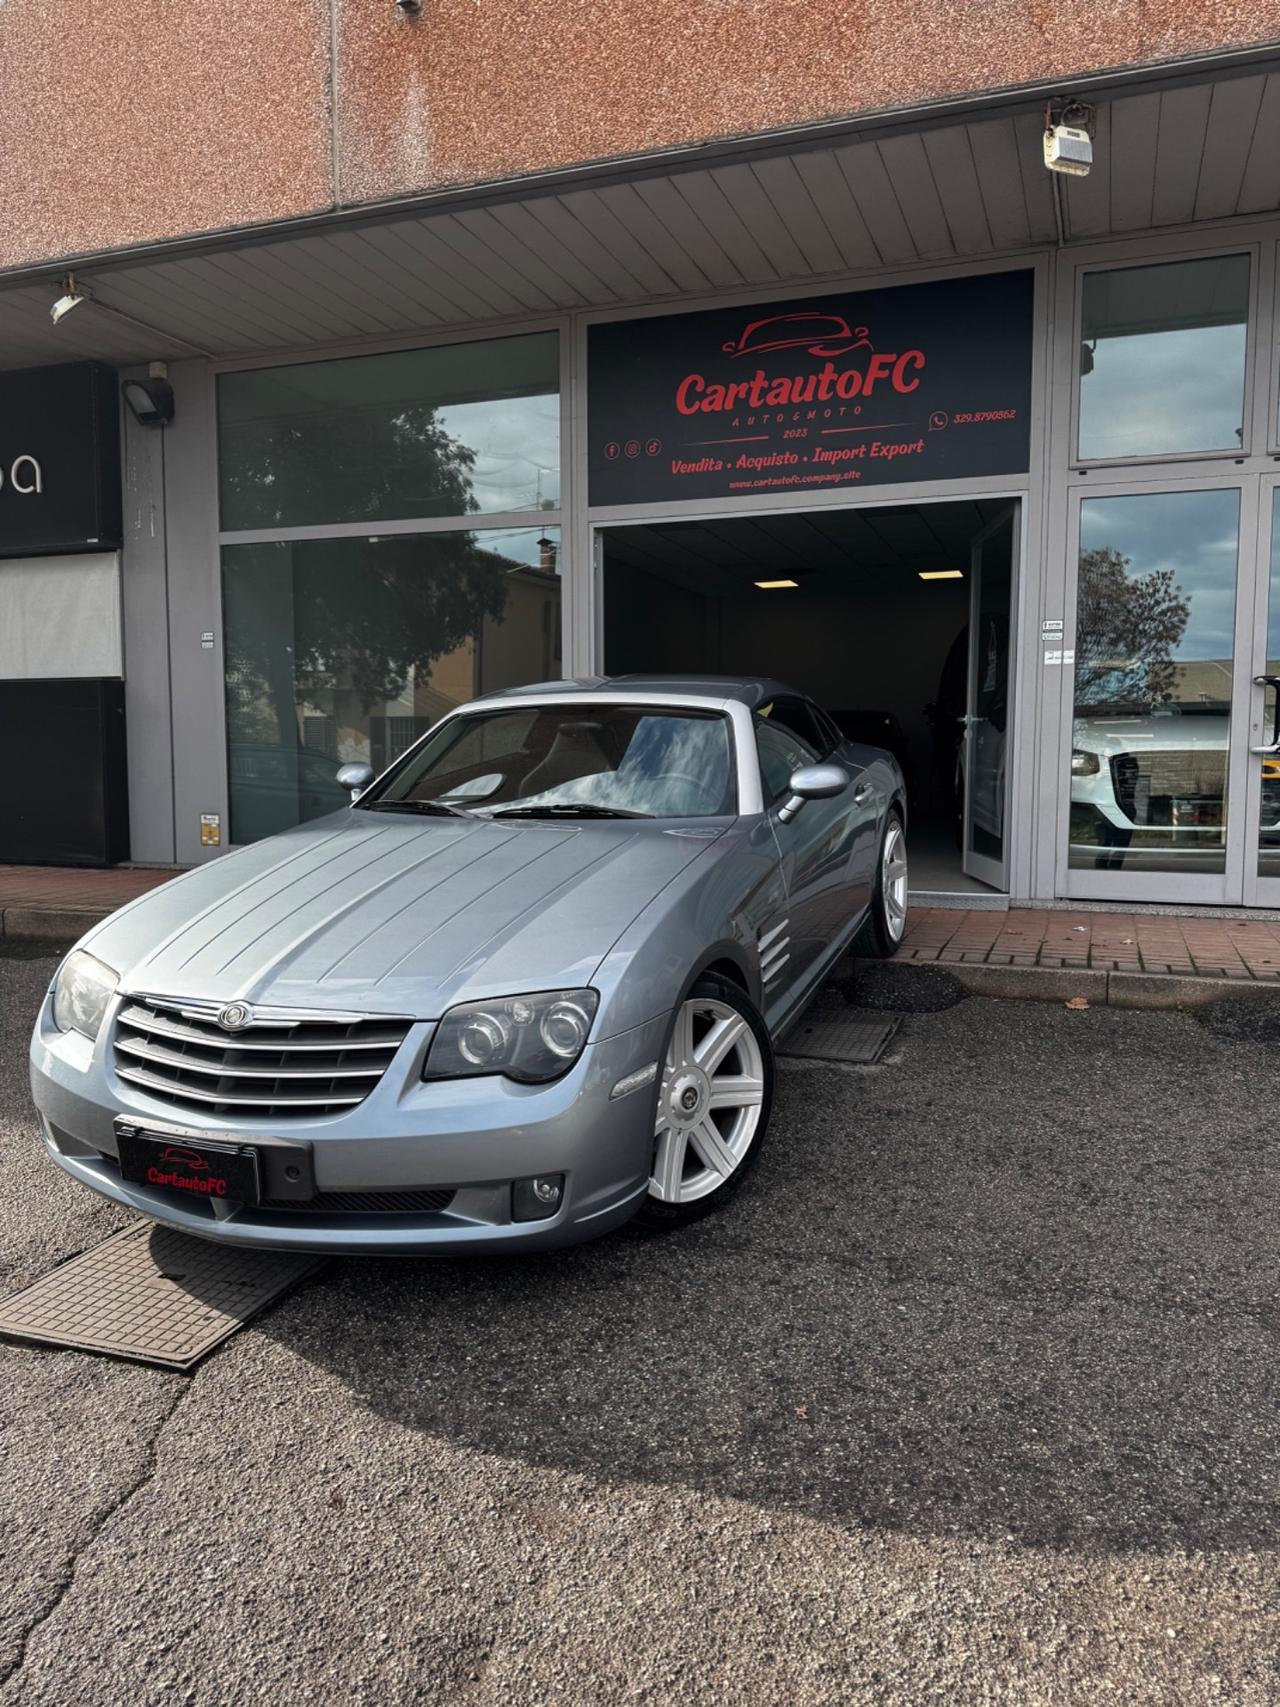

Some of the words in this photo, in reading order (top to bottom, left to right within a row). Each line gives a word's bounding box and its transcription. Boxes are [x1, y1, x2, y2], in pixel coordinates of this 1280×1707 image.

[676, 350, 926, 415] CartautoFC
[783, 429, 809, 440] 2023
[671, 453, 723, 475] Vendita
[736, 450, 799, 472] Acquisto
[812, 445, 867, 466] Import
[869, 438, 925, 461] Export
[146, 1167, 227, 1195] CartautoFC
